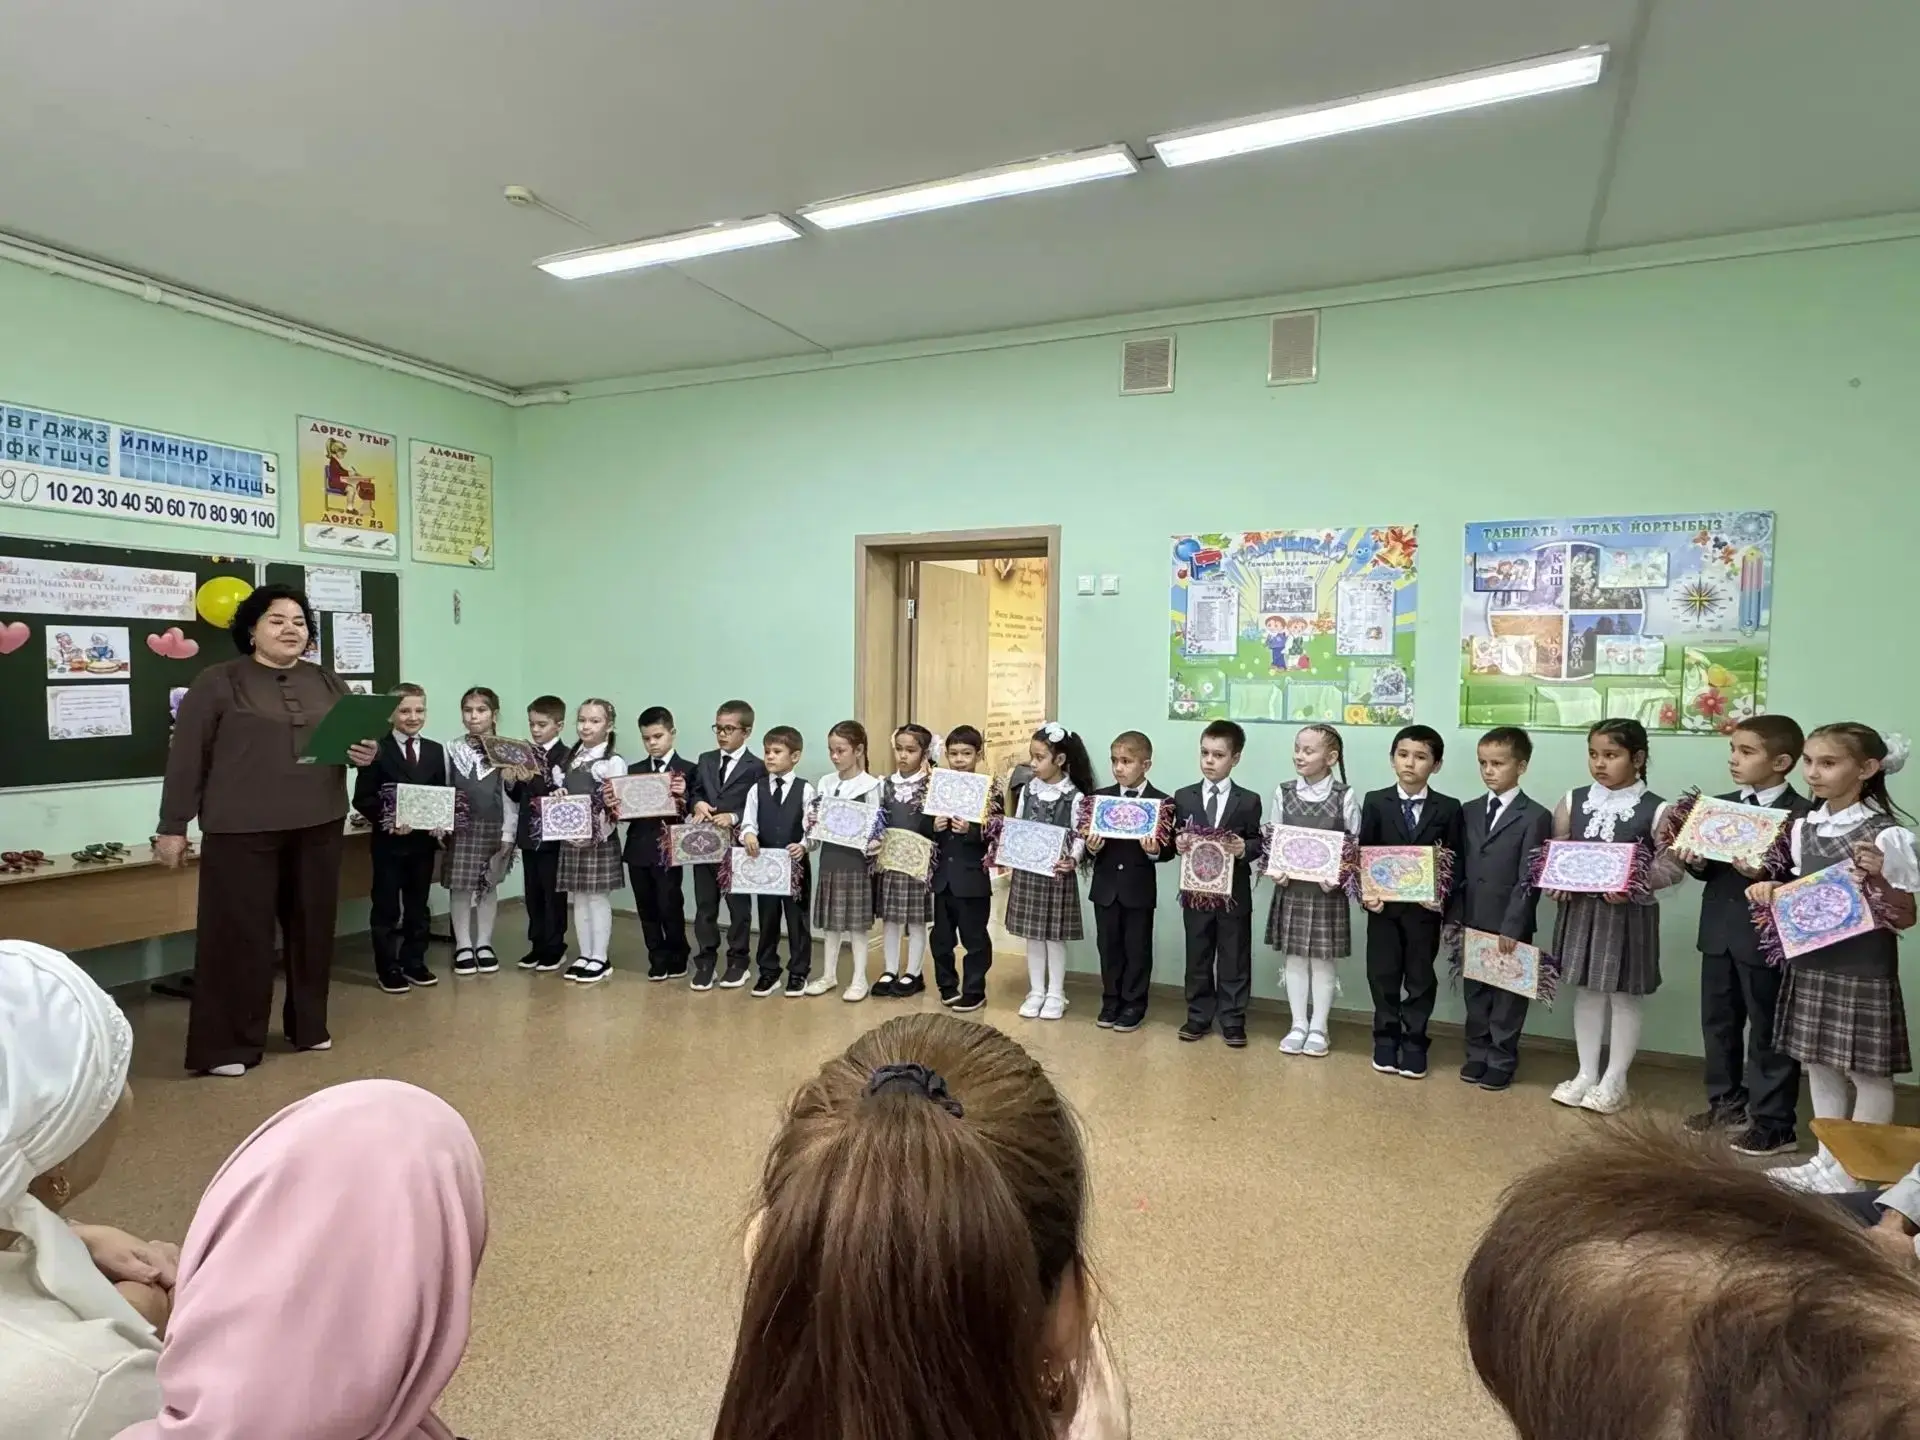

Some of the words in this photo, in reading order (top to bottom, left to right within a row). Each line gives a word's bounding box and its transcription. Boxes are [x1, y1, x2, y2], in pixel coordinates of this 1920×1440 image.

[310, 422, 352, 439] ДӨРЕС
[358, 432, 390, 447] УТЫР
[429, 446, 476, 462] АЛФАВИТ
[46, 481, 67, 501] 10
[72, 485, 93, 505] 20
[98, 489, 117, 508] 30
[121, 493, 141, 511] 40
[145, 496, 163, 514] 50
[167, 499, 185, 517] 60
[189, 501, 206, 520] 70
[210, 504, 227, 522] 80
[230, 508, 247, 525] 90
[251, 510, 274, 528] 100
[321, 513, 363, 527] ДӨРЕС
[369, 519, 384, 529] ЯЗ
[1482, 525, 1559, 539] ТАБИГАТЬ
[1572, 522, 1621, 535] УРТАК
[1631, 519, 1722, 533] ЙОРТЫБЫЗ
[1550, 553, 1563, 586] КЫШ
